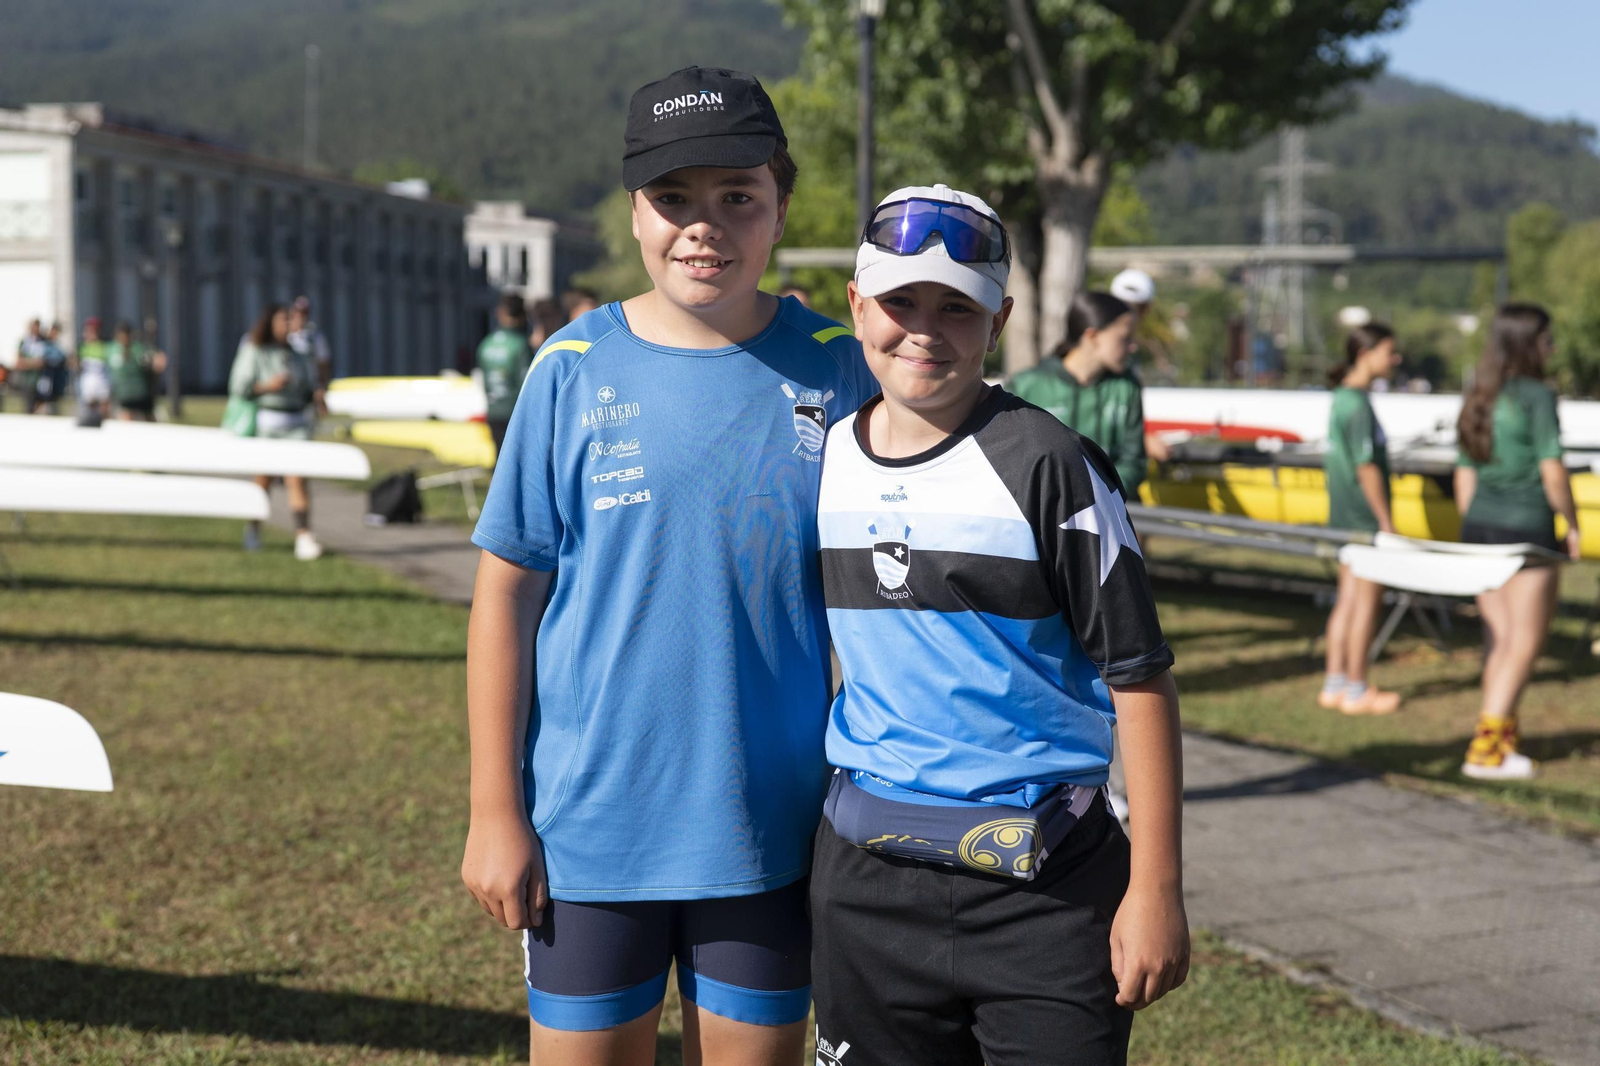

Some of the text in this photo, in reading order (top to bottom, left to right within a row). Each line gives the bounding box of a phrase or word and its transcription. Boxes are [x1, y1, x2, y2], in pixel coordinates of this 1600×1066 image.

[654, 105, 725, 122] SHIPBUILDERS
[581, 402, 640, 428] MARINERO
[880, 492, 908, 502] sputnik
